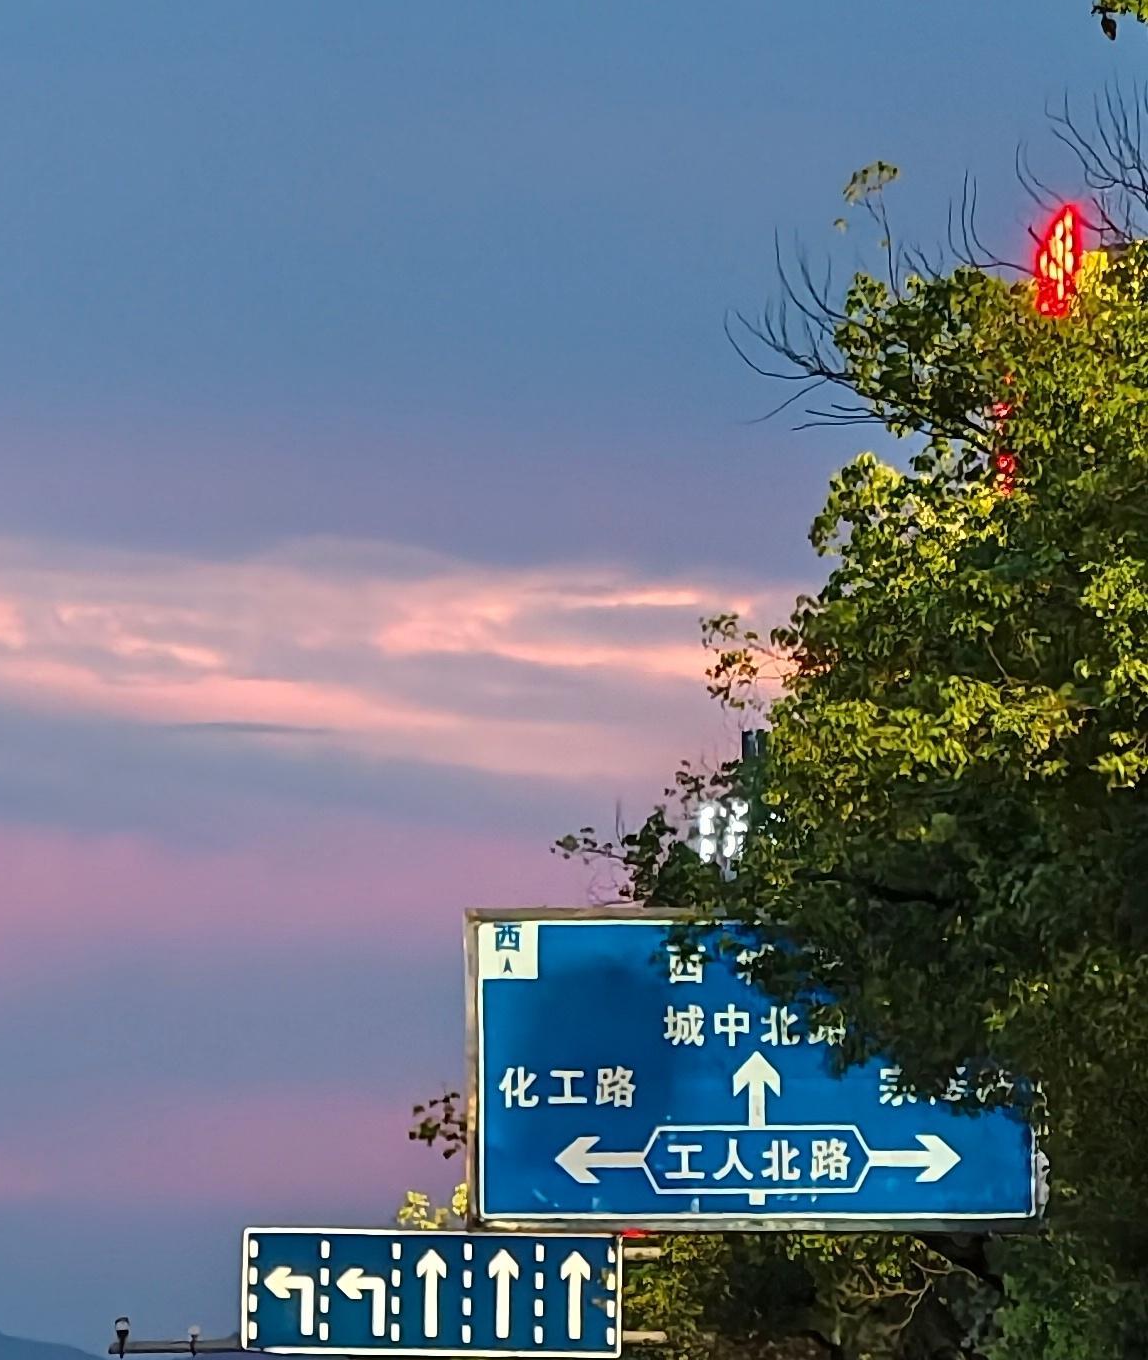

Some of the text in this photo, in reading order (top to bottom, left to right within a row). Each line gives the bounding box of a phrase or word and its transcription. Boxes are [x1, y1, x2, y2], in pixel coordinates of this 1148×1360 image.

[493, 922, 522, 952] 西
[498, 1065, 636, 1108] 化工路
[664, 1138, 851, 1181] 工人北路
